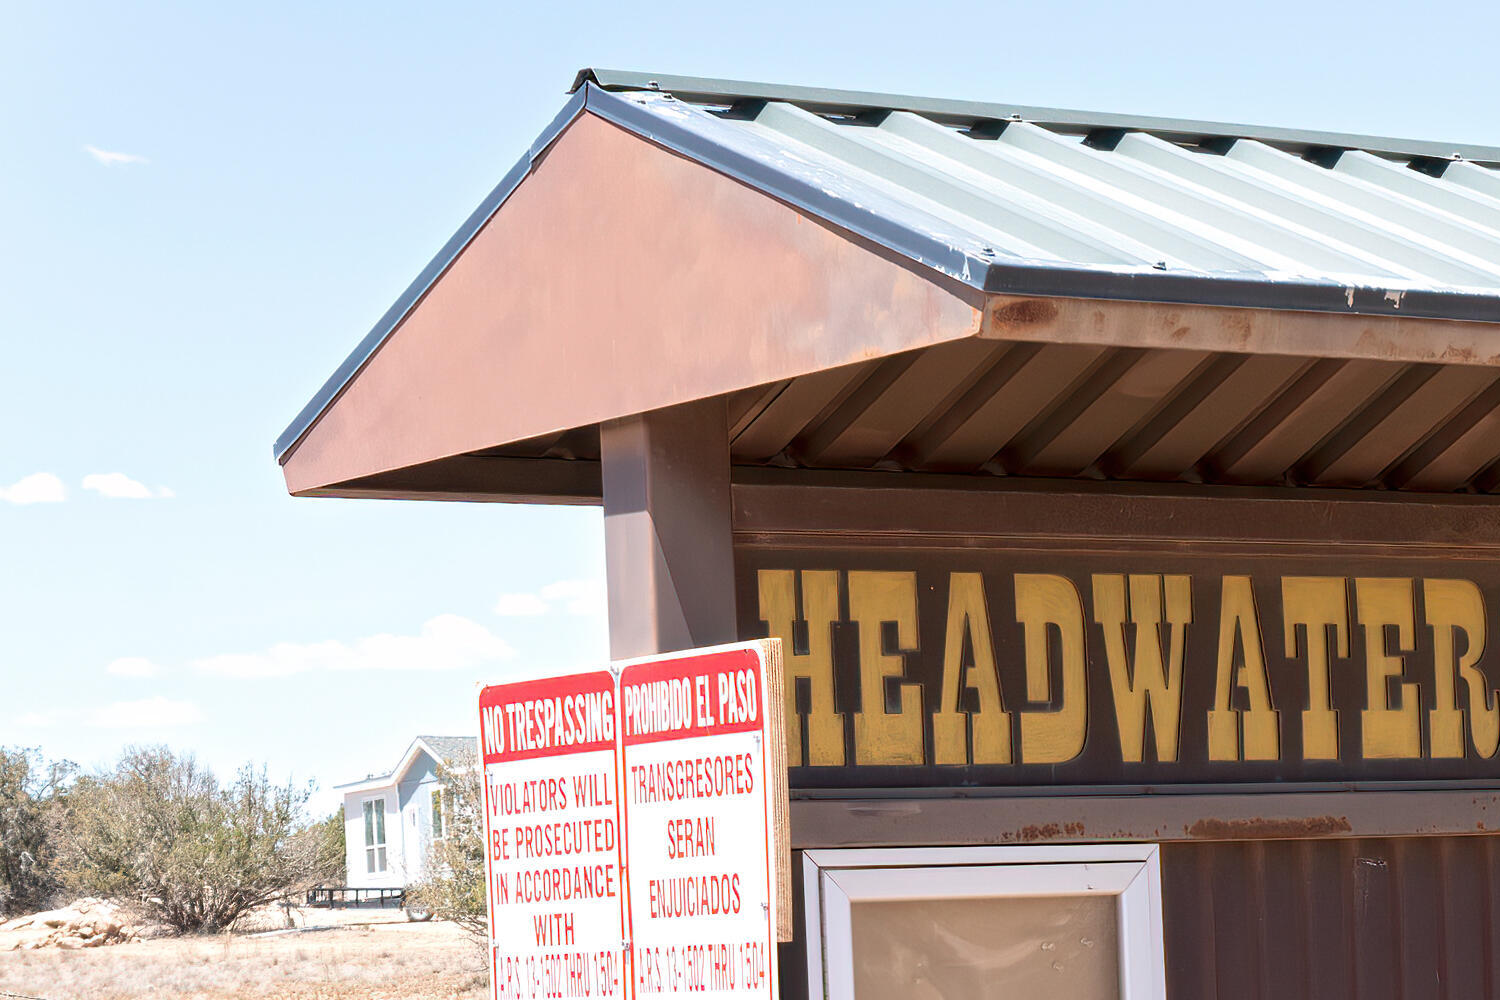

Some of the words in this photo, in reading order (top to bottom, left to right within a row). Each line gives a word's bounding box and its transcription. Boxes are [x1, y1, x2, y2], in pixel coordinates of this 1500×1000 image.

[483, 704, 505, 755] NO
[506, 690, 614, 752] TRESPASSING
[624, 676, 692, 736] PROHIBIDO
[695, 675, 715, 727] EL
[718, 668, 758, 724] PASO
[490, 776, 567, 816] VIOLATORS
[573, 773, 613, 808] WILL
[631, 752, 754, 805] TRANSGRESORES
[492, 828, 510, 860] BE
[516, 818, 615, 859] PROSECUTED
[667, 816, 716, 860] SERAN
[496, 872, 509, 905] IN
[515, 864, 616, 904] ACCORDANCE
[649, 872, 741, 919] ENJUICIADOS
[533, 912, 575, 947] WITH
[526, 953, 562, 1000] 13-1502
[564, 952, 590, 998] THRU
[593, 950, 619, 997] 1504
[666, 944, 705, 992] 13-1502
[708, 943, 736, 991] THRU
[739, 942, 766, 990] 1504
